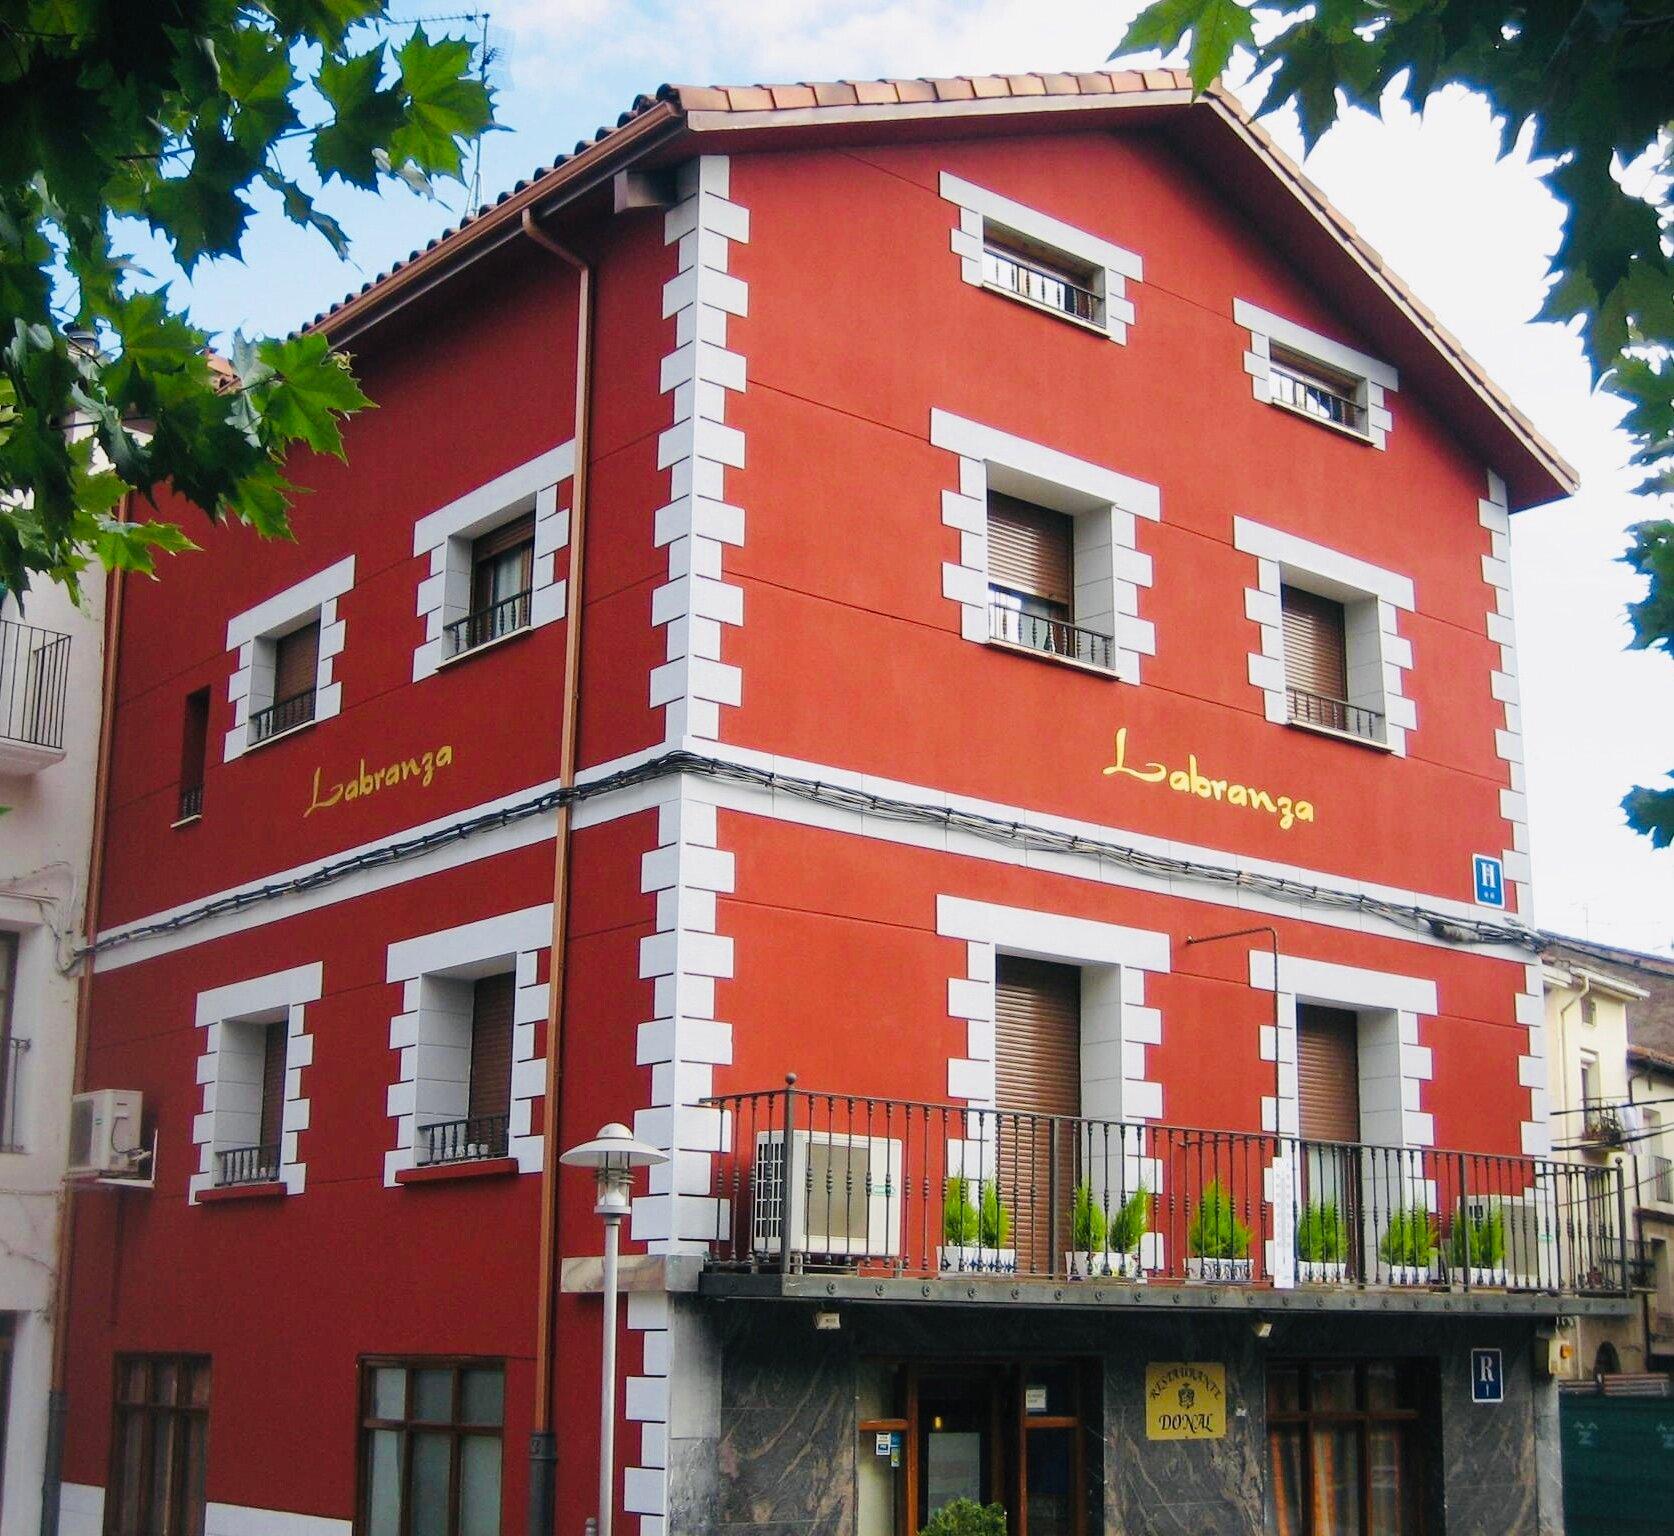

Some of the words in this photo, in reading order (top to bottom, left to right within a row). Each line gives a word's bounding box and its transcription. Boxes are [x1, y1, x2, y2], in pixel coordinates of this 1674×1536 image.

[303, 745, 452, 818] Labranza
[1102, 727, 1314, 830] Labranza
[1481, 862, 1497, 888] H
[1480, 1355, 1495, 1382] R
[1158, 1413, 1213, 1434] DONAL
